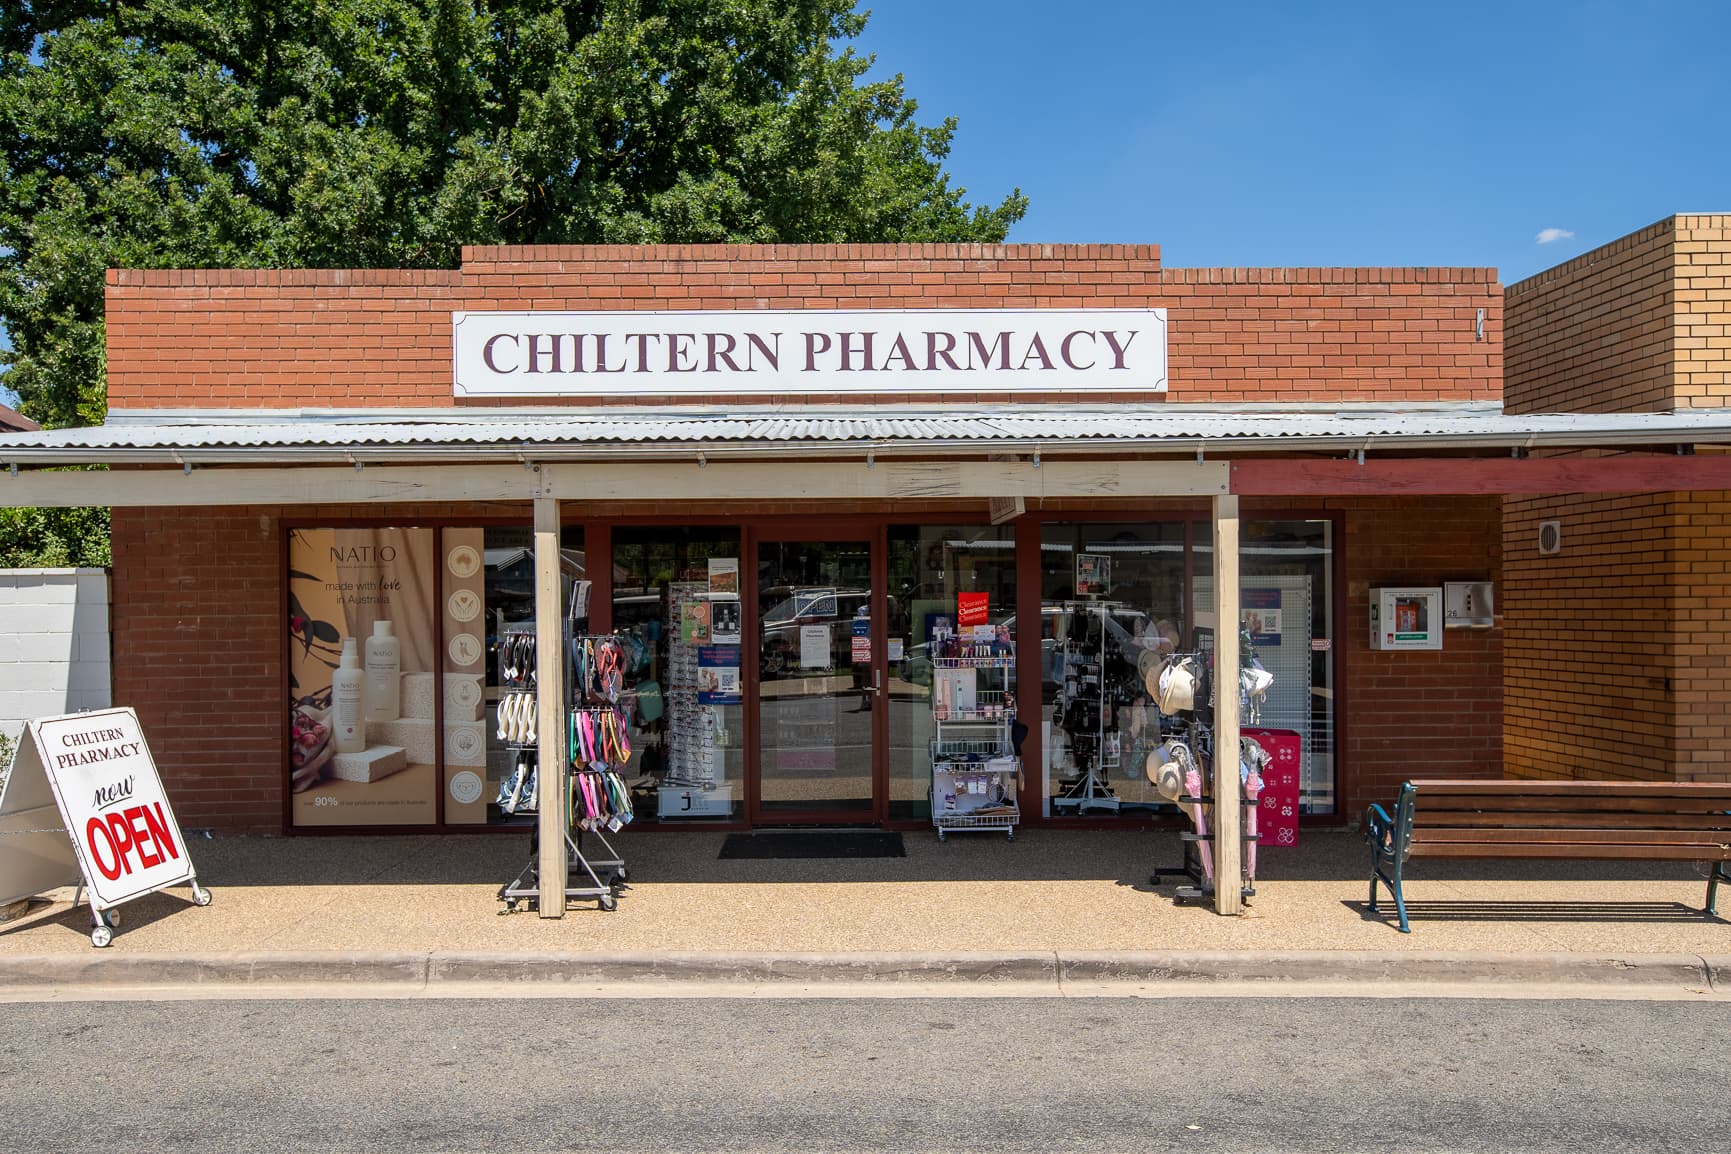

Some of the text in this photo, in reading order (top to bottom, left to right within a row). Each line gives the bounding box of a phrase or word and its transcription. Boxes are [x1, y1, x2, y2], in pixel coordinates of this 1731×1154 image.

[484, 330, 1138, 374] CHILTERN PHARMACY
[330, 546, 396, 562] NATIO
[325, 575, 401, 592] made with love
[336, 594, 346, 605] in
[958, 605, 988, 616] Clearance
[1447, 609, 1457, 617] 26
[62, 728, 124, 747] CHILTERN
[56, 742, 140, 769] PHARMACY
[92, 774, 135, 808] now
[314, 796, 338, 807] 90%
[86, 802, 179, 880] OPEN
